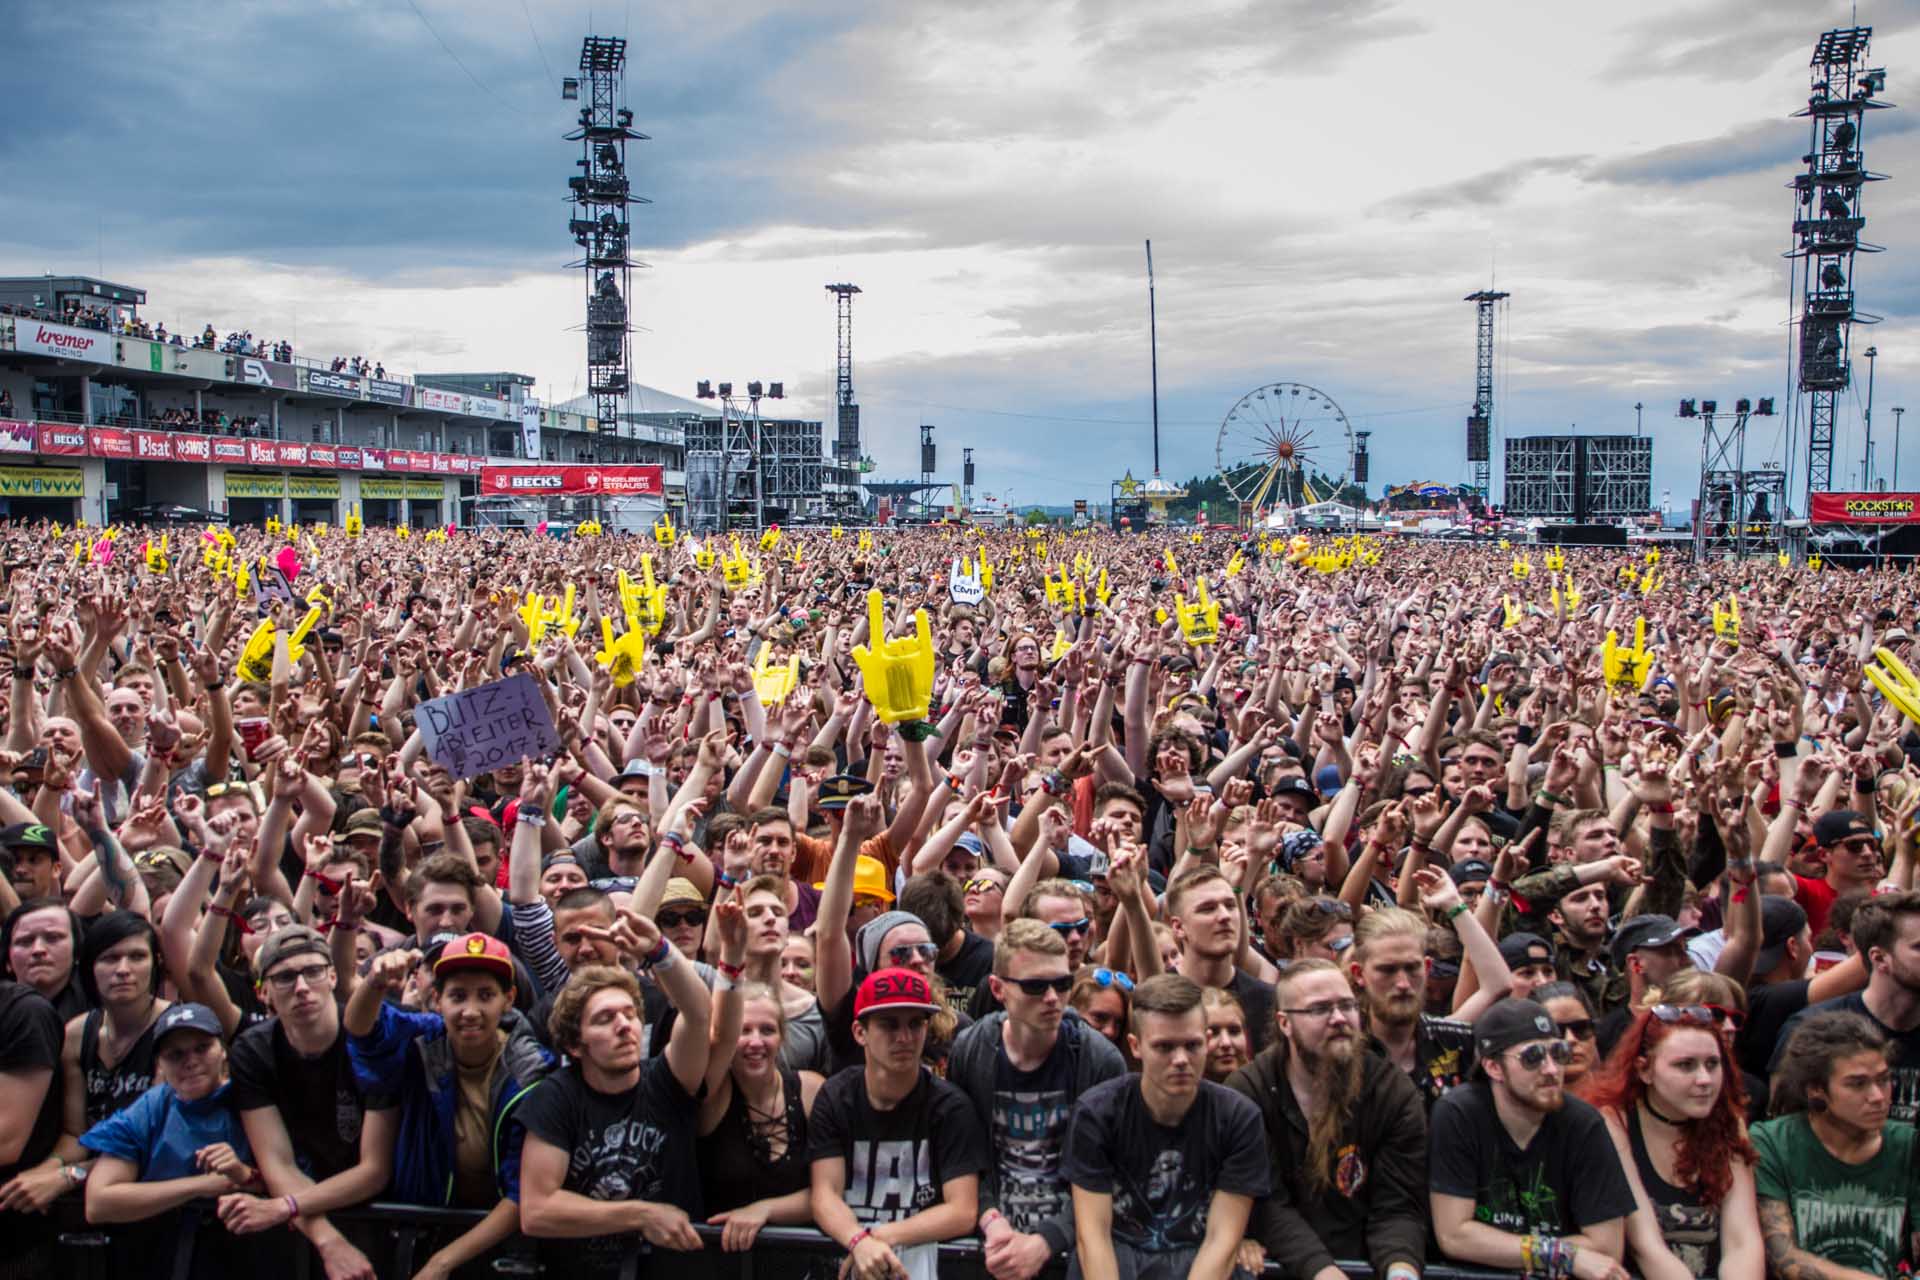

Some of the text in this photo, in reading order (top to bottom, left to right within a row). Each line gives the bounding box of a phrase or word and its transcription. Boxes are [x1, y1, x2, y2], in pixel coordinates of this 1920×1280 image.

[36, 325, 94, 350] kremer
[48, 346, 83, 358] RACING
[1762, 462, 1780, 470] WC
[512, 476, 563, 488] BECK'S
[603, 482, 650, 490] STRAUSS
[435, 708, 544, 761] ABLEITER
[471, 736, 531, 768] 2017
